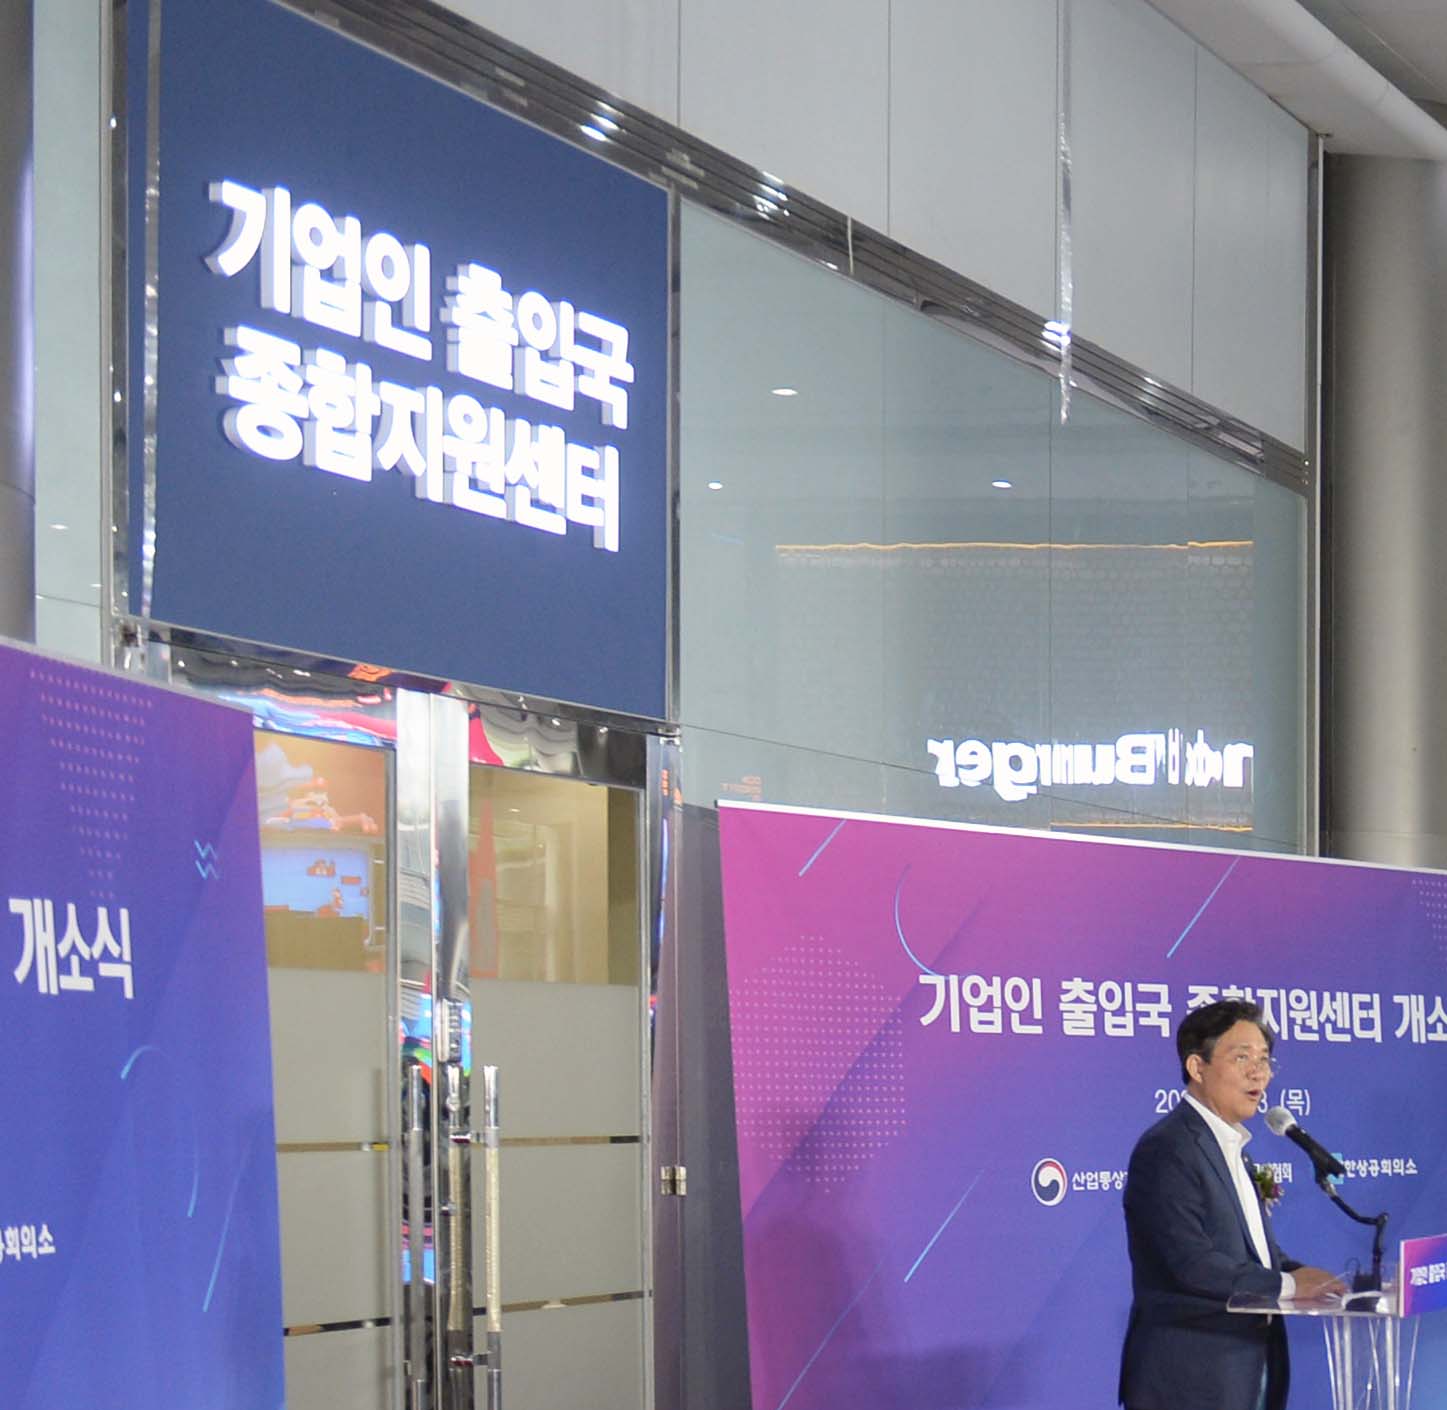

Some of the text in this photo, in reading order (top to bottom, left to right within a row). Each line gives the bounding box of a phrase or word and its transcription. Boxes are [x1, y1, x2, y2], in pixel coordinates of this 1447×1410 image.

[206, 178, 634, 430] 기업인 출입국
[215, 323, 619, 553] 종합지원센터
[8, 898, 134, 999] 개소식
[919, 975, 1044, 1034] 기업인
[1059, 978, 1172, 1038] 출입국
[1280, 1088, 1311, 1116] (목)
